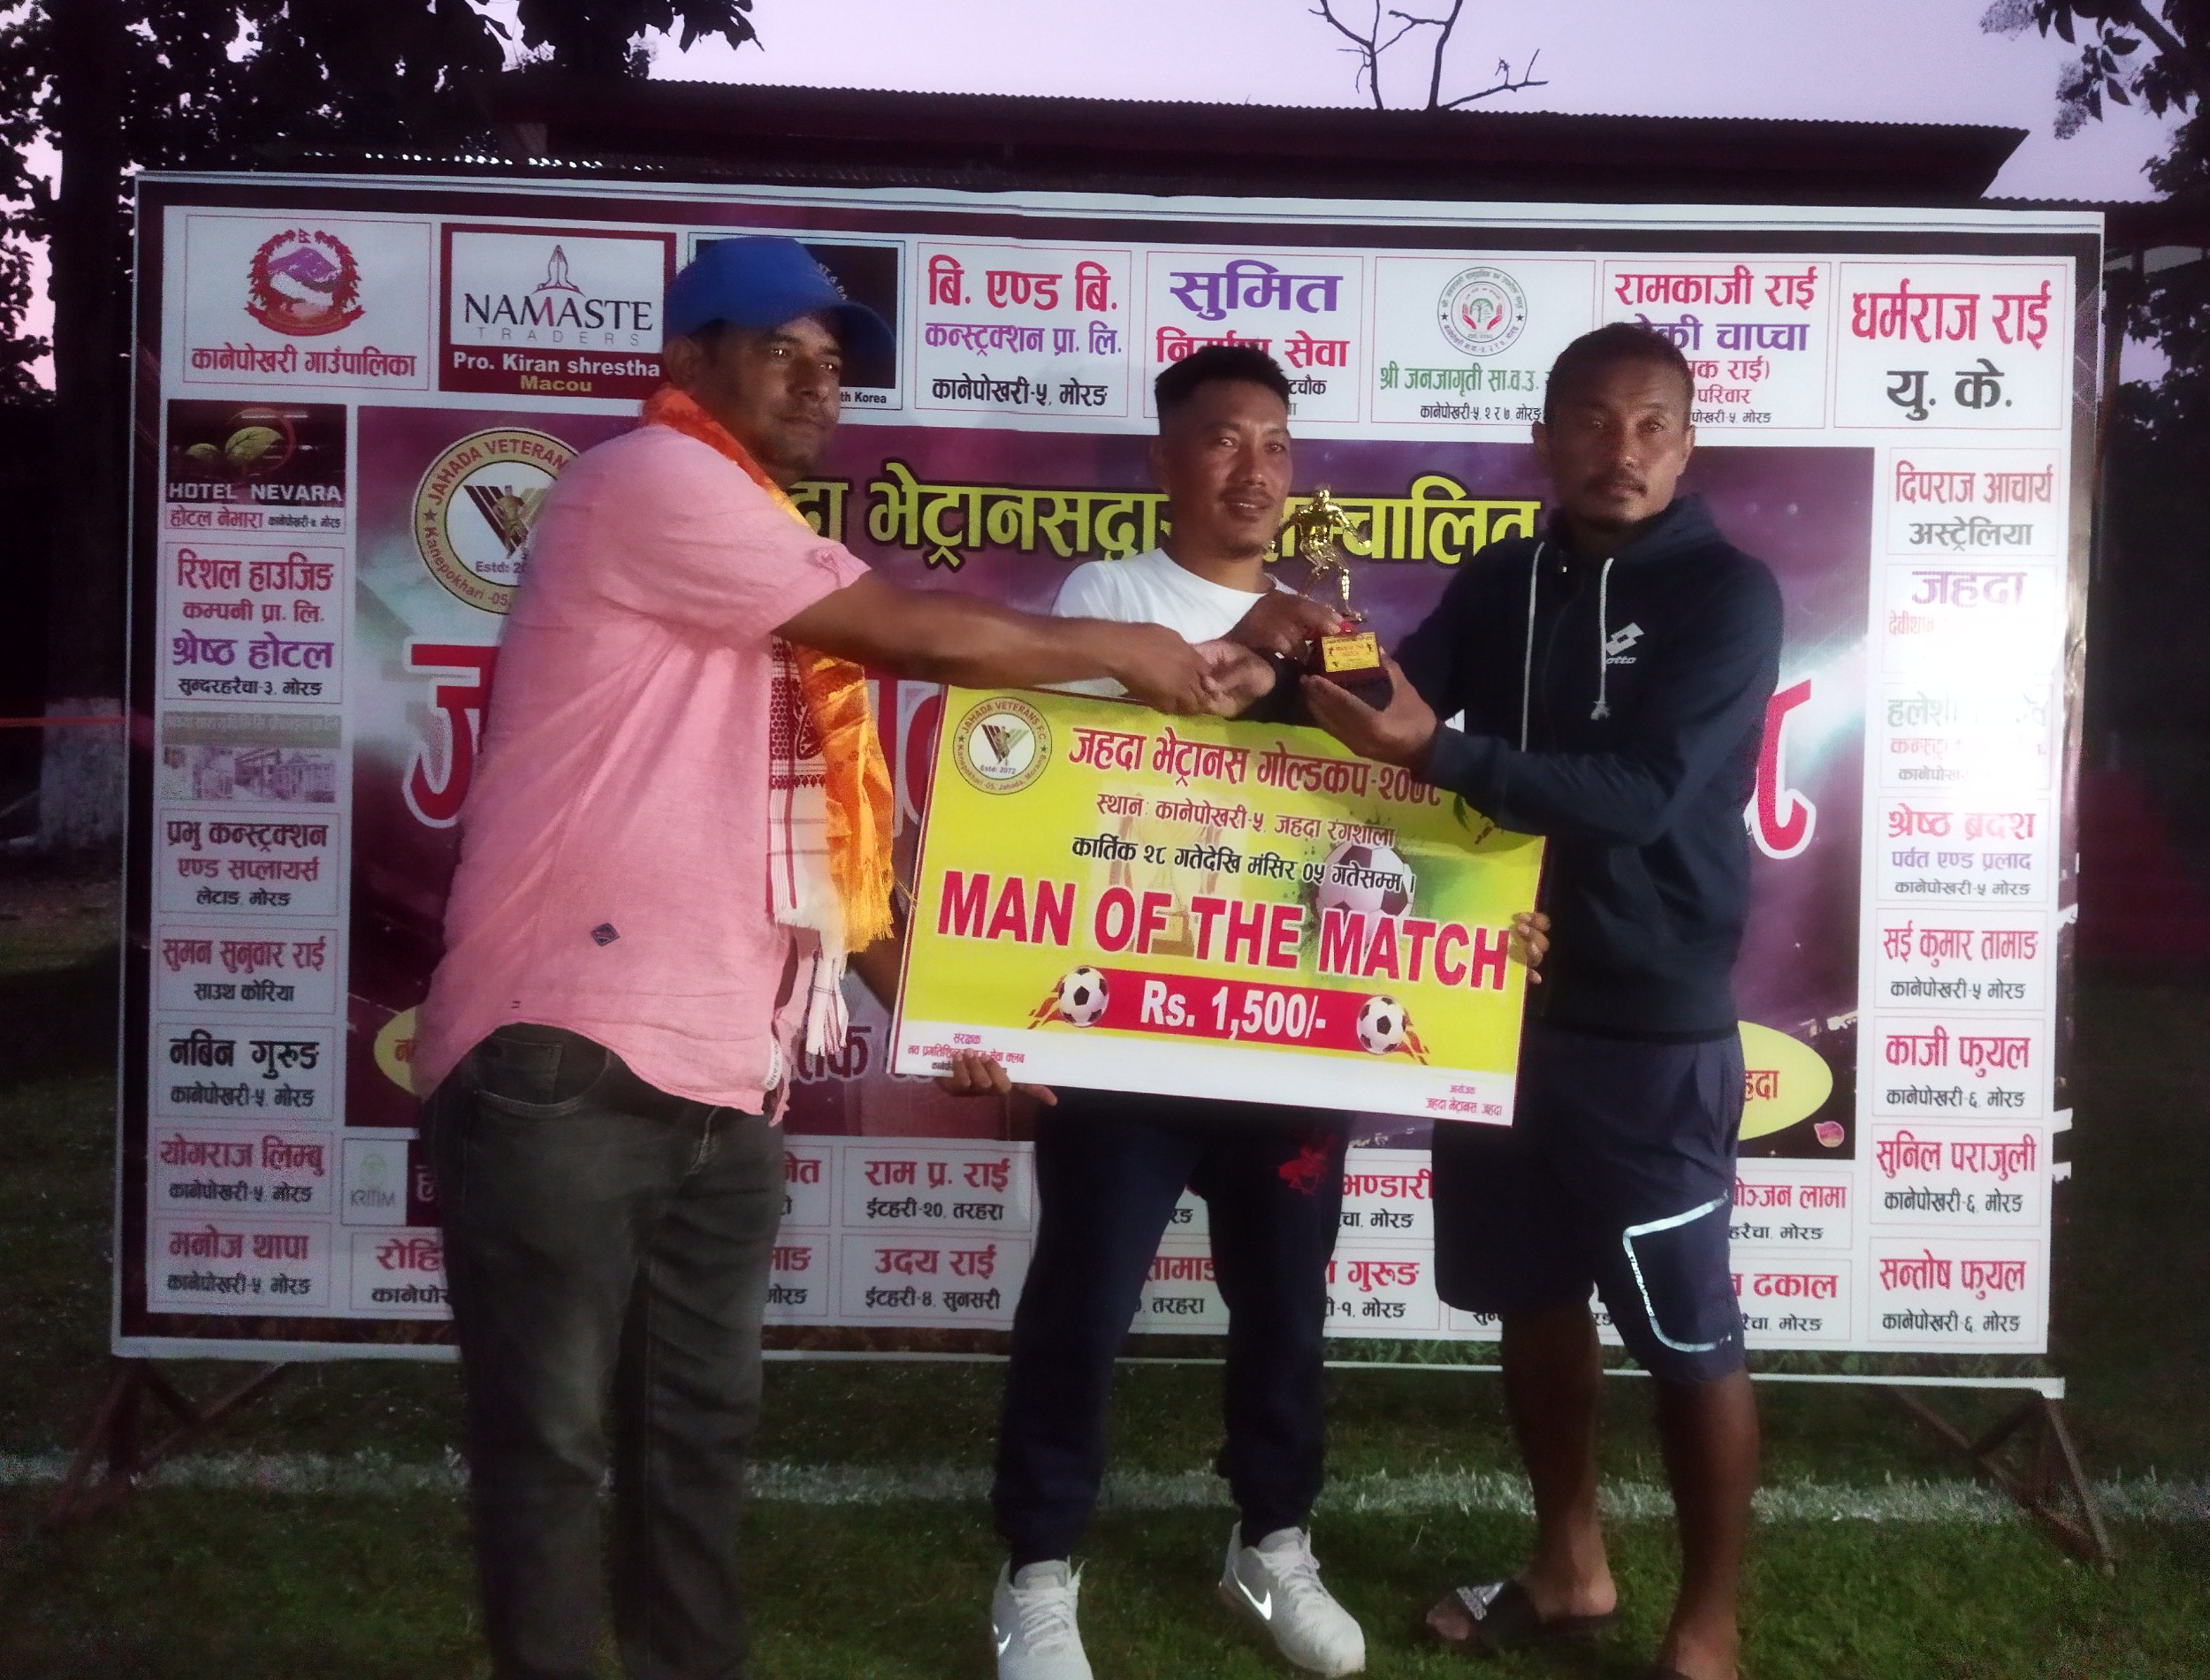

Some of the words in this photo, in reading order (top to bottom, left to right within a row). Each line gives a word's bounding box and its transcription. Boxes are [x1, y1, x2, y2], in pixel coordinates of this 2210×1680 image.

[928, 254, 971, 306] बि.
[987, 270, 1063, 311] एण्ड
[1075, 260, 1117, 313] बि.
[1170, 259, 1344, 321] सुमित
[1614, 264, 1753, 305] रामकाजी
[1765, 266, 1818, 309] राई
[464, 293, 652, 331] NAMASTE
[1851, 278, 1980, 343] धर्मराज
[1993, 279, 2052, 350] राई
[478, 327, 640, 346] TRADERS
[925, 322, 1045, 356] कन्स्ट्रक्शन
[1052, 328, 1079, 356] प्रा.
[1088, 321, 1122, 355] लि.
[1284, 330, 1350, 369] सेवा
[1717, 323, 1810, 351] चाप्चा
[192, 342, 296, 375] कानेपोखरी
[304, 346, 416, 376] गाउँपालिका
[453, 352, 494, 372] Pro.
[502, 353, 560, 375] Kiran
[568, 355, 660, 377] shrestha
[1727, 355, 1771, 382] राई)
[520, 375, 592, 392] Macou
[1059, 378, 1109, 407] मोरङ
[1380, 361, 1399, 390] श्री
[1405, 364, 1482, 397] जनजागृती
[1886, 369, 1937, 422] यु.
[1955, 358, 2013, 410] के.
[855, 391, 887, 404] Korea
[1696, 384, 1751, 404] परिवार
[1516, 404, 1542, 421] मोरङ
[1742, 410, 1772, 424] मोरङ
[428, 445, 484, 506] JAHADA
[484, 438, 569, 471] VETERAN
[1895, 460, 1976, 504] दिपराज
[1984, 464, 2054, 504] आचार्य
[169, 483, 237, 500] HOTEL
[250, 484, 343, 503] NEVARA
[170, 506, 212, 528] होटल
[1909, 516, 2034, 551] अस्ट्रेलिया
[177, 548, 242, 590] रिशल
[248, 551, 335, 592] हाउजिङ
[1911, 571, 2028, 608] जहदा
[183, 598, 253, 621] कम्पनी
[262, 604, 287, 623] प्रा.
[294, 599, 324, 623] लि.
[172, 628, 237, 666] श्रेष्ठ
[248, 631, 334, 669] होटल
[283, 678, 323, 696] मोरङ
[1069, 726, 1146, 772] जहदा
[1153, 726, 1250, 785] भेट्रानस
[1274, 813, 1322, 839] जहदा
[1328, 817, 1395, 847] रंगशाला
[1888, 802, 1955, 838] श्रेष्ठ
[167, 821, 202, 851] प्रभु
[209, 822, 329, 853] कन्स्ट्रक्शन
[178, 858, 221, 878] एण्ड
[228, 856, 319, 881] सप्लायर्स
[1071, 833, 1138, 863] कार्तिक
[1143, 844, 1165, 865] २८
[1174, 842, 1241, 872] गतेदेखि
[1247, 851, 1298, 881] मंसिर
[1302, 863, 1327, 886] ०५
[1330, 860, 1405, 892] गतेसम्म
[1892, 846, 1931, 869] पर्वत
[1937, 852, 1974, 869] एण्ड
[249, 887, 291, 907] मोरङ
[1992, 878, 2031, 895] मोरङ
[938, 870, 1076, 944] MAN
[1094, 888, 1171, 954] OF
[1193, 898, 1302, 968] THE
[1319, 907, 1509, 989] MATCH
[1884, 920, 1913, 962] सई
[1920, 930, 1975, 968] कुमार
[1981, 931, 2039, 961] तामाङ
[163, 939, 213, 971] सुमन
[219, 940, 286, 973] सुनुवार
[293, 936, 327, 971] राई
[241, 979, 294, 1002] कोरिया
[1988, 979, 2026, 1000] मोरङ
[1140, 981, 1195, 1027] Rs.
[1211, 985, 1326, 1041] 1,500/-
[170, 1029, 237, 1068] नबिन
[1886, 1025, 1950, 1067] काजी
[1959, 1036, 2031, 1077] फुयल
[274, 1083, 315, 1108] मोरङ
[1987, 1087, 2025, 1107] मोरङ
[1877, 1130, 1943, 1177] सुनिल
[1950, 1134, 2037, 1181] पराजुली
[865, 1160, 917, 1186] राम
[927, 1162, 953, 1189] प्र.
[964, 1158, 1010, 1192] राई
[1800, 1185, 1847, 1209] लामा
[1985, 1189, 2023, 1213] मोरङ
[953, 1203, 1004, 1221] तरहरा
[1370, 1207, 1414, 1228] मोरङ
[169, 1224, 244, 1258] मनोज
[253, 1235, 309, 1260] थापा
[1779, 1223, 1825, 1240] मोरङ
[874, 1248, 940, 1275] उदय
[949, 1244, 997, 1279] राई
[1879, 1250, 1953, 1291] सन्तोष
[1961, 1259, 2027, 1300] फुयल
[942, 1288, 1001, 1311] सुनसरी
[1753, 1273, 1839, 1299] ढकाल
[1152, 1296, 1205, 1314] तरहरा
[1361, 1296, 1406, 1319] मोरङ
[1779, 1314, 1823, 1332] मोरङ
[1983, 1311, 2021, 1333] मोरङ
